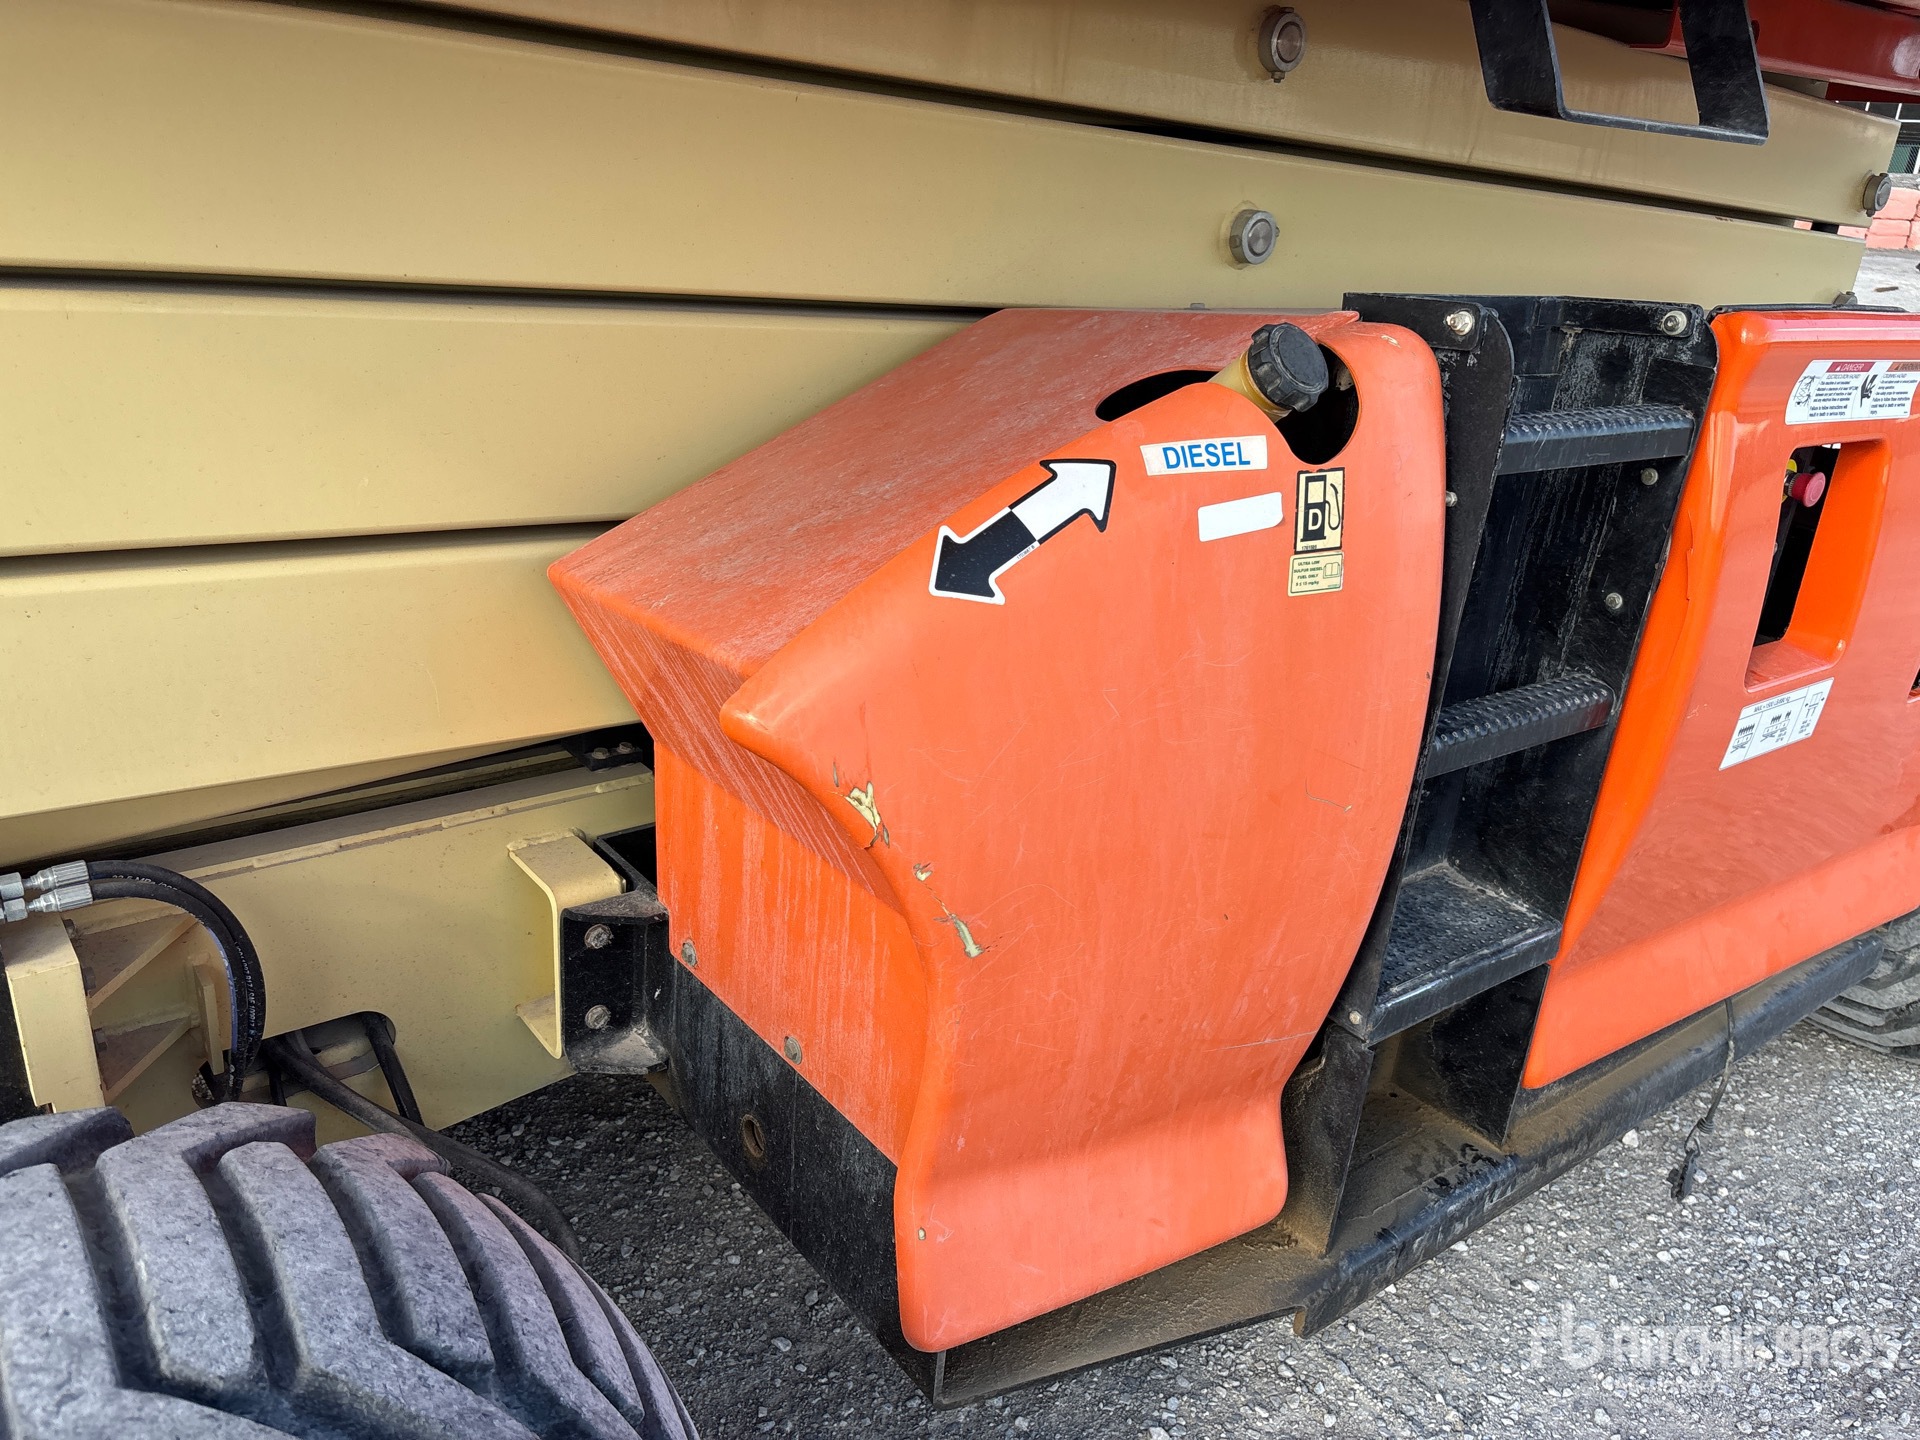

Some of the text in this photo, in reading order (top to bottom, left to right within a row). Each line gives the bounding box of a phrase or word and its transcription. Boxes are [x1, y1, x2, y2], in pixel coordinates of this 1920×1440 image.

[1840, 363, 1865, 372] DANGER
[1162, 442, 1250, 470] DIESEL
[1308, 508, 1322, 530] D
